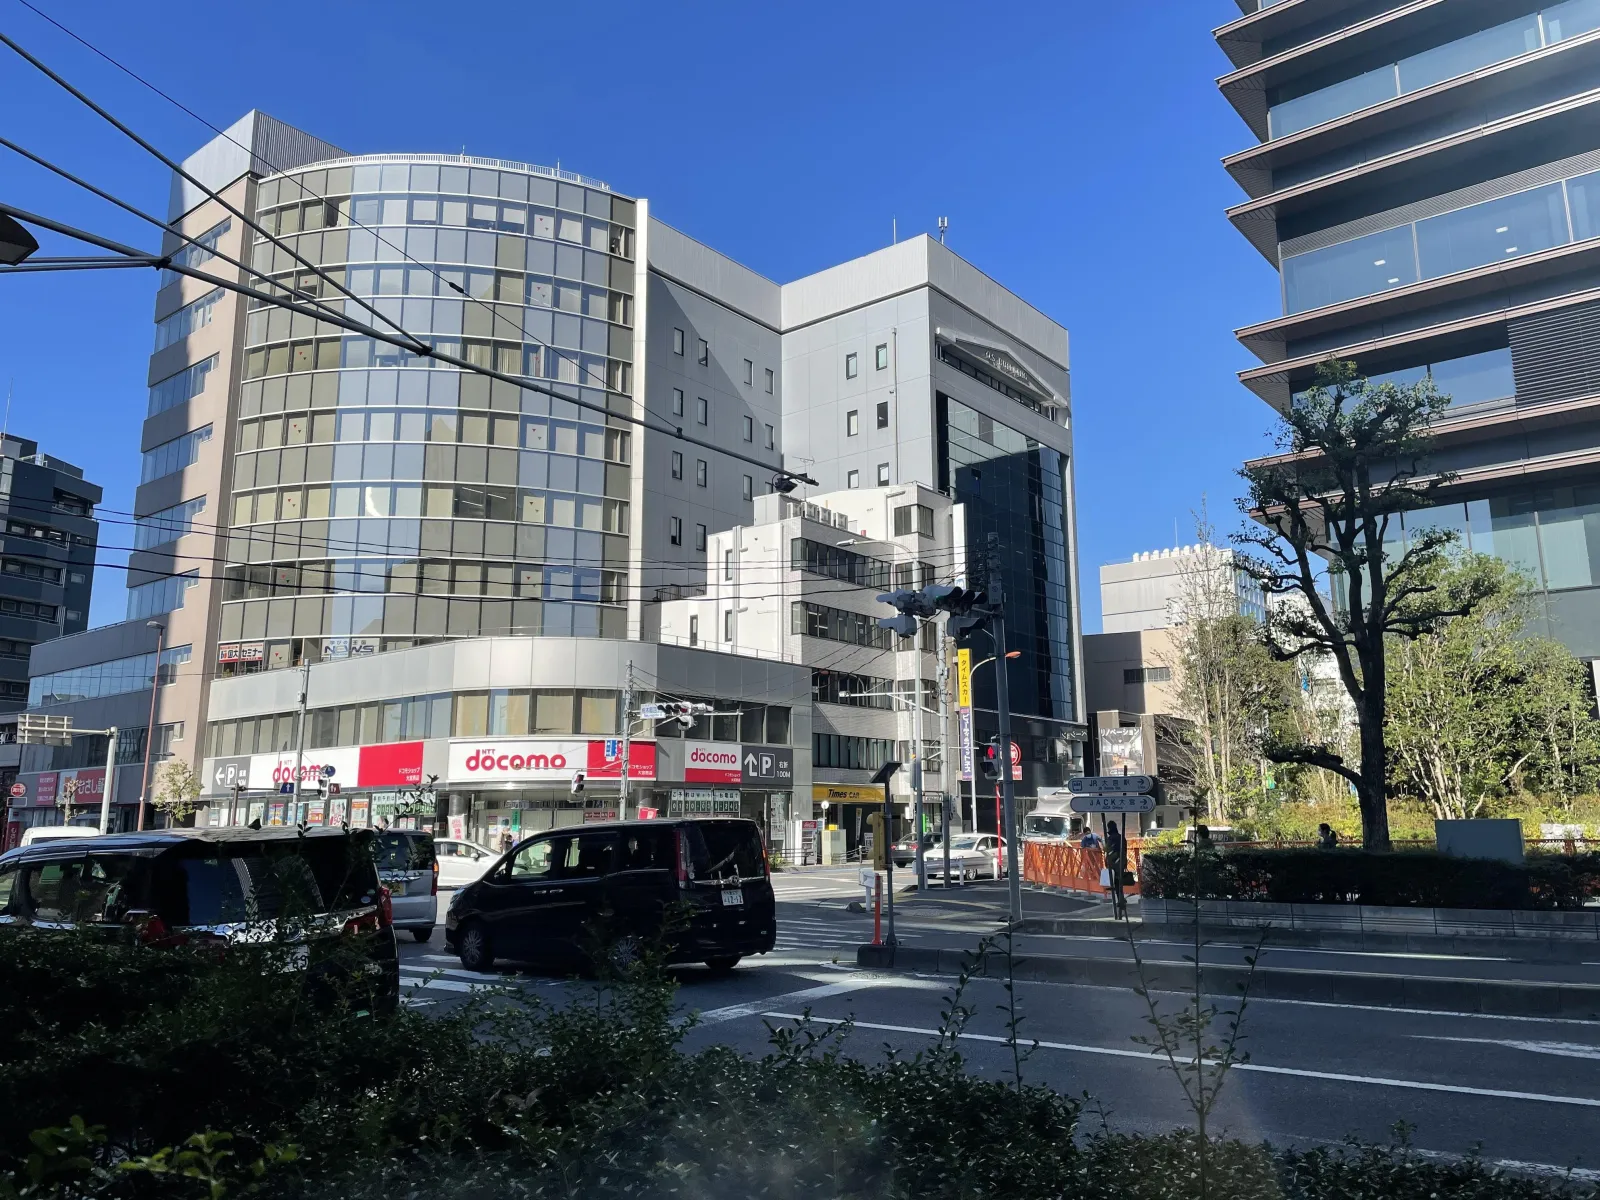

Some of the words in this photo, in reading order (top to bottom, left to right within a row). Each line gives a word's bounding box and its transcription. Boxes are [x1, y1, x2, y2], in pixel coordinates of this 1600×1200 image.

[1100, 728, 1139, 737] リノベーション
[465, 749, 567, 772] docomo
[691, 748, 737, 764] docomo
[272, 760, 328, 783] docom
[762, 757, 772, 775] P
[226, 767, 235, 784] P
[828, 788, 847, 798] Times
